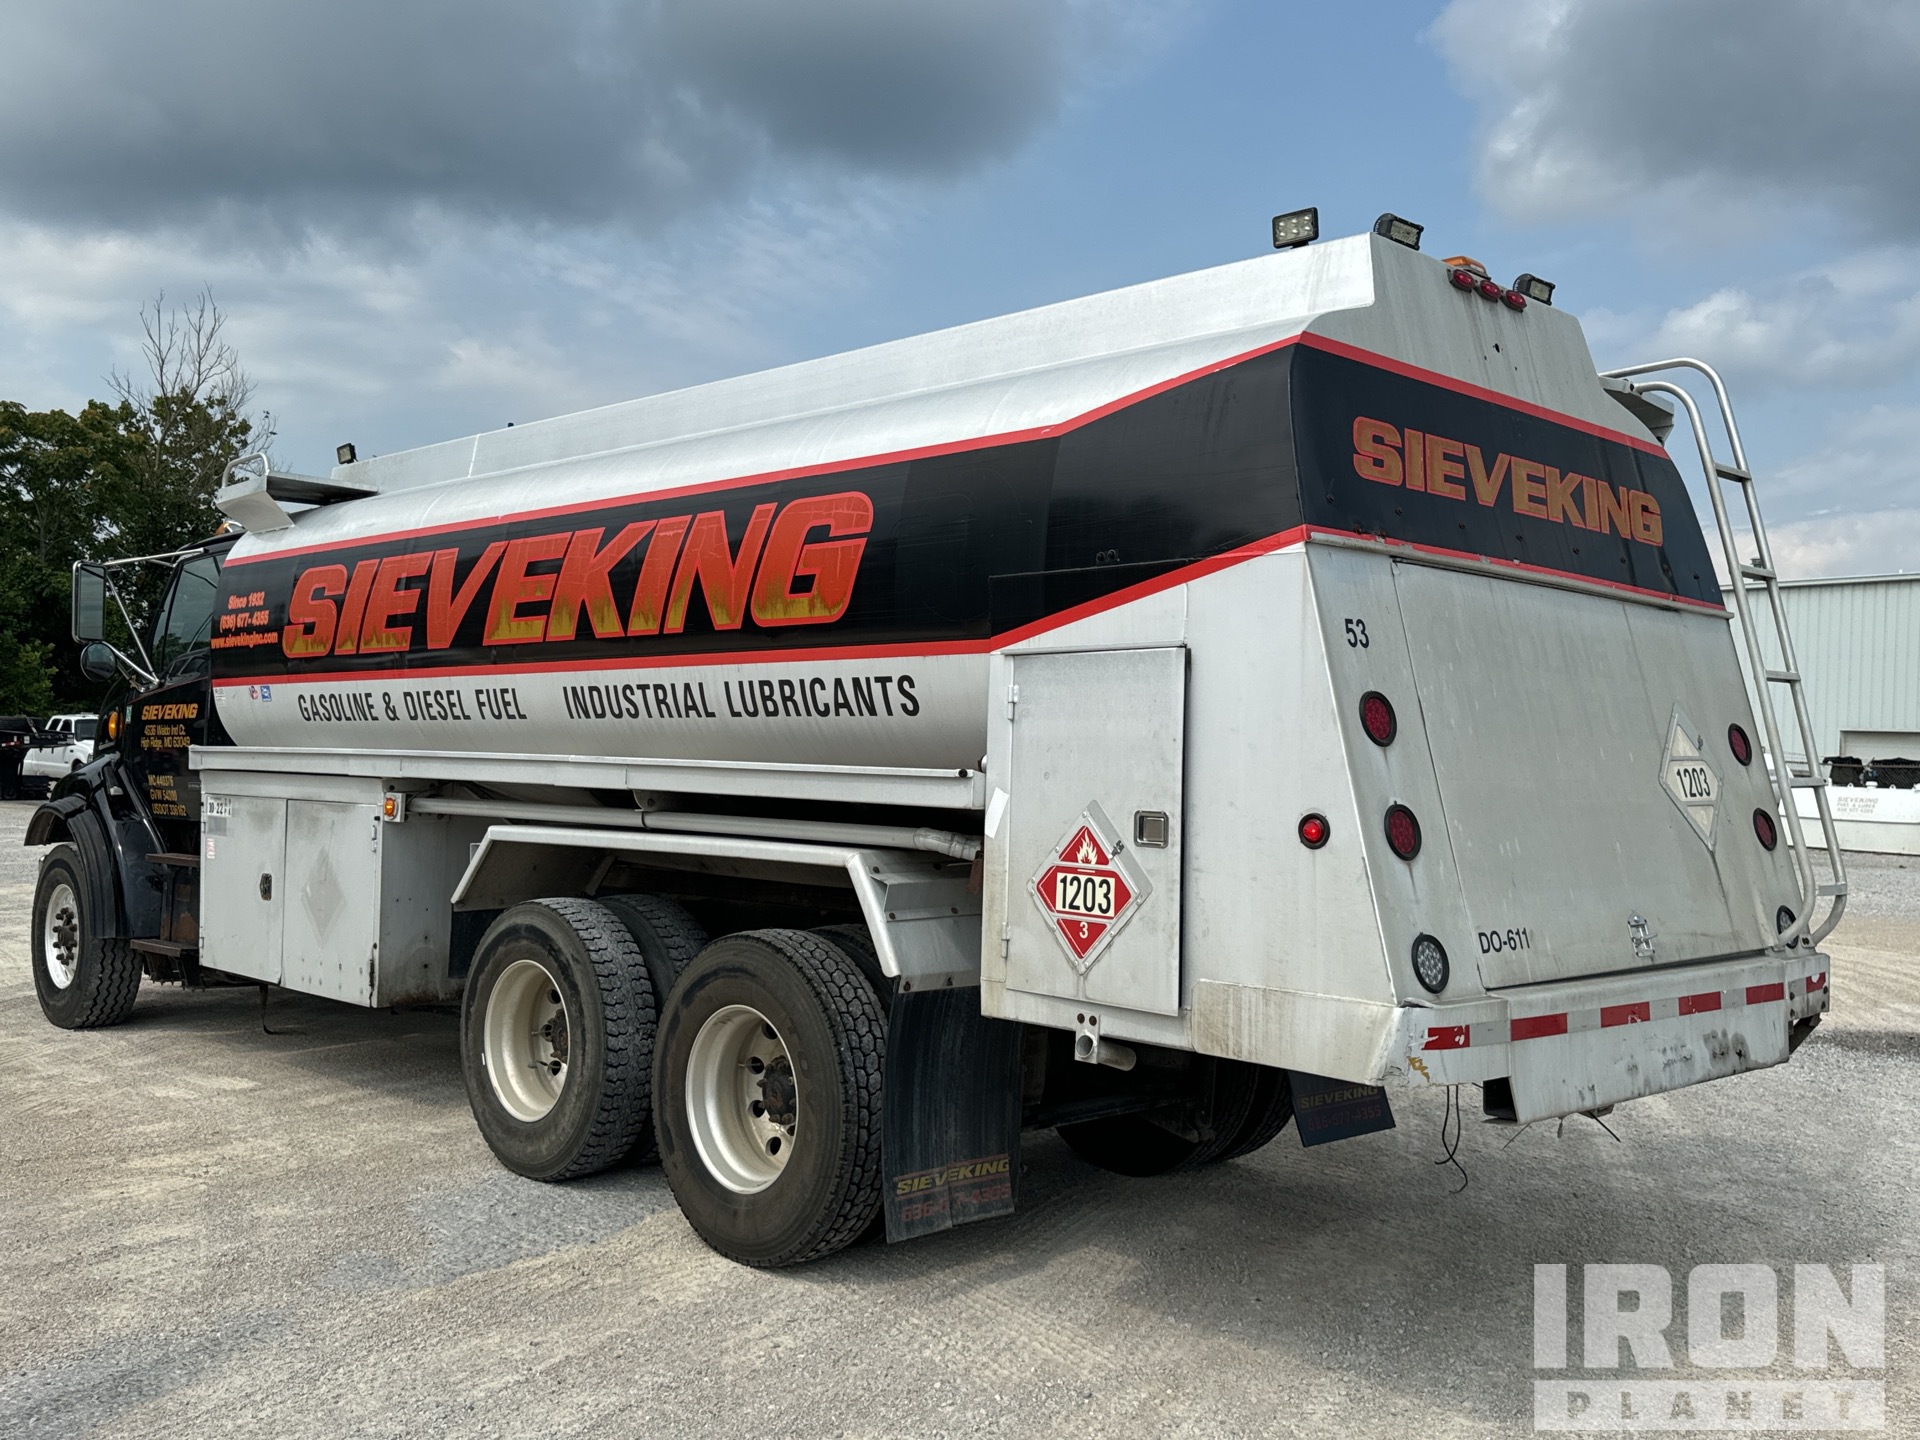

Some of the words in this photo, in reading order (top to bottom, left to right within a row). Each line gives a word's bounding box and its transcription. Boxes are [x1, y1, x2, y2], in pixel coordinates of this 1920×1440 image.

[1353, 416, 1663, 547] SIEVEKING
[283, 491, 875, 658] SIEVEKING
[228, 594, 248, 610] Since
[249, 591, 265, 607] 1932
[1344, 618, 1370, 648] 53
[141, 703, 199, 720] SIEVEKING
[297, 690, 380, 723] GASOLINE
[384, 695, 398, 721] &
[404, 690, 471, 721] DIESEL
[477, 688, 528, 720] FUEL
[563, 682, 716, 721] INDUSTRIAL
[728, 674, 921, 718] LUBRICANTS
[1676, 767, 1711, 798] 1203
[1060, 874, 1111, 915] 1203
[1079, 921, 1089, 939] 3
[1478, 928, 1531, 954] DO-611
[1301, 1086, 1378, 1110] SIEVEKING
[896, 1158, 1010, 1196] SIEVEKING
